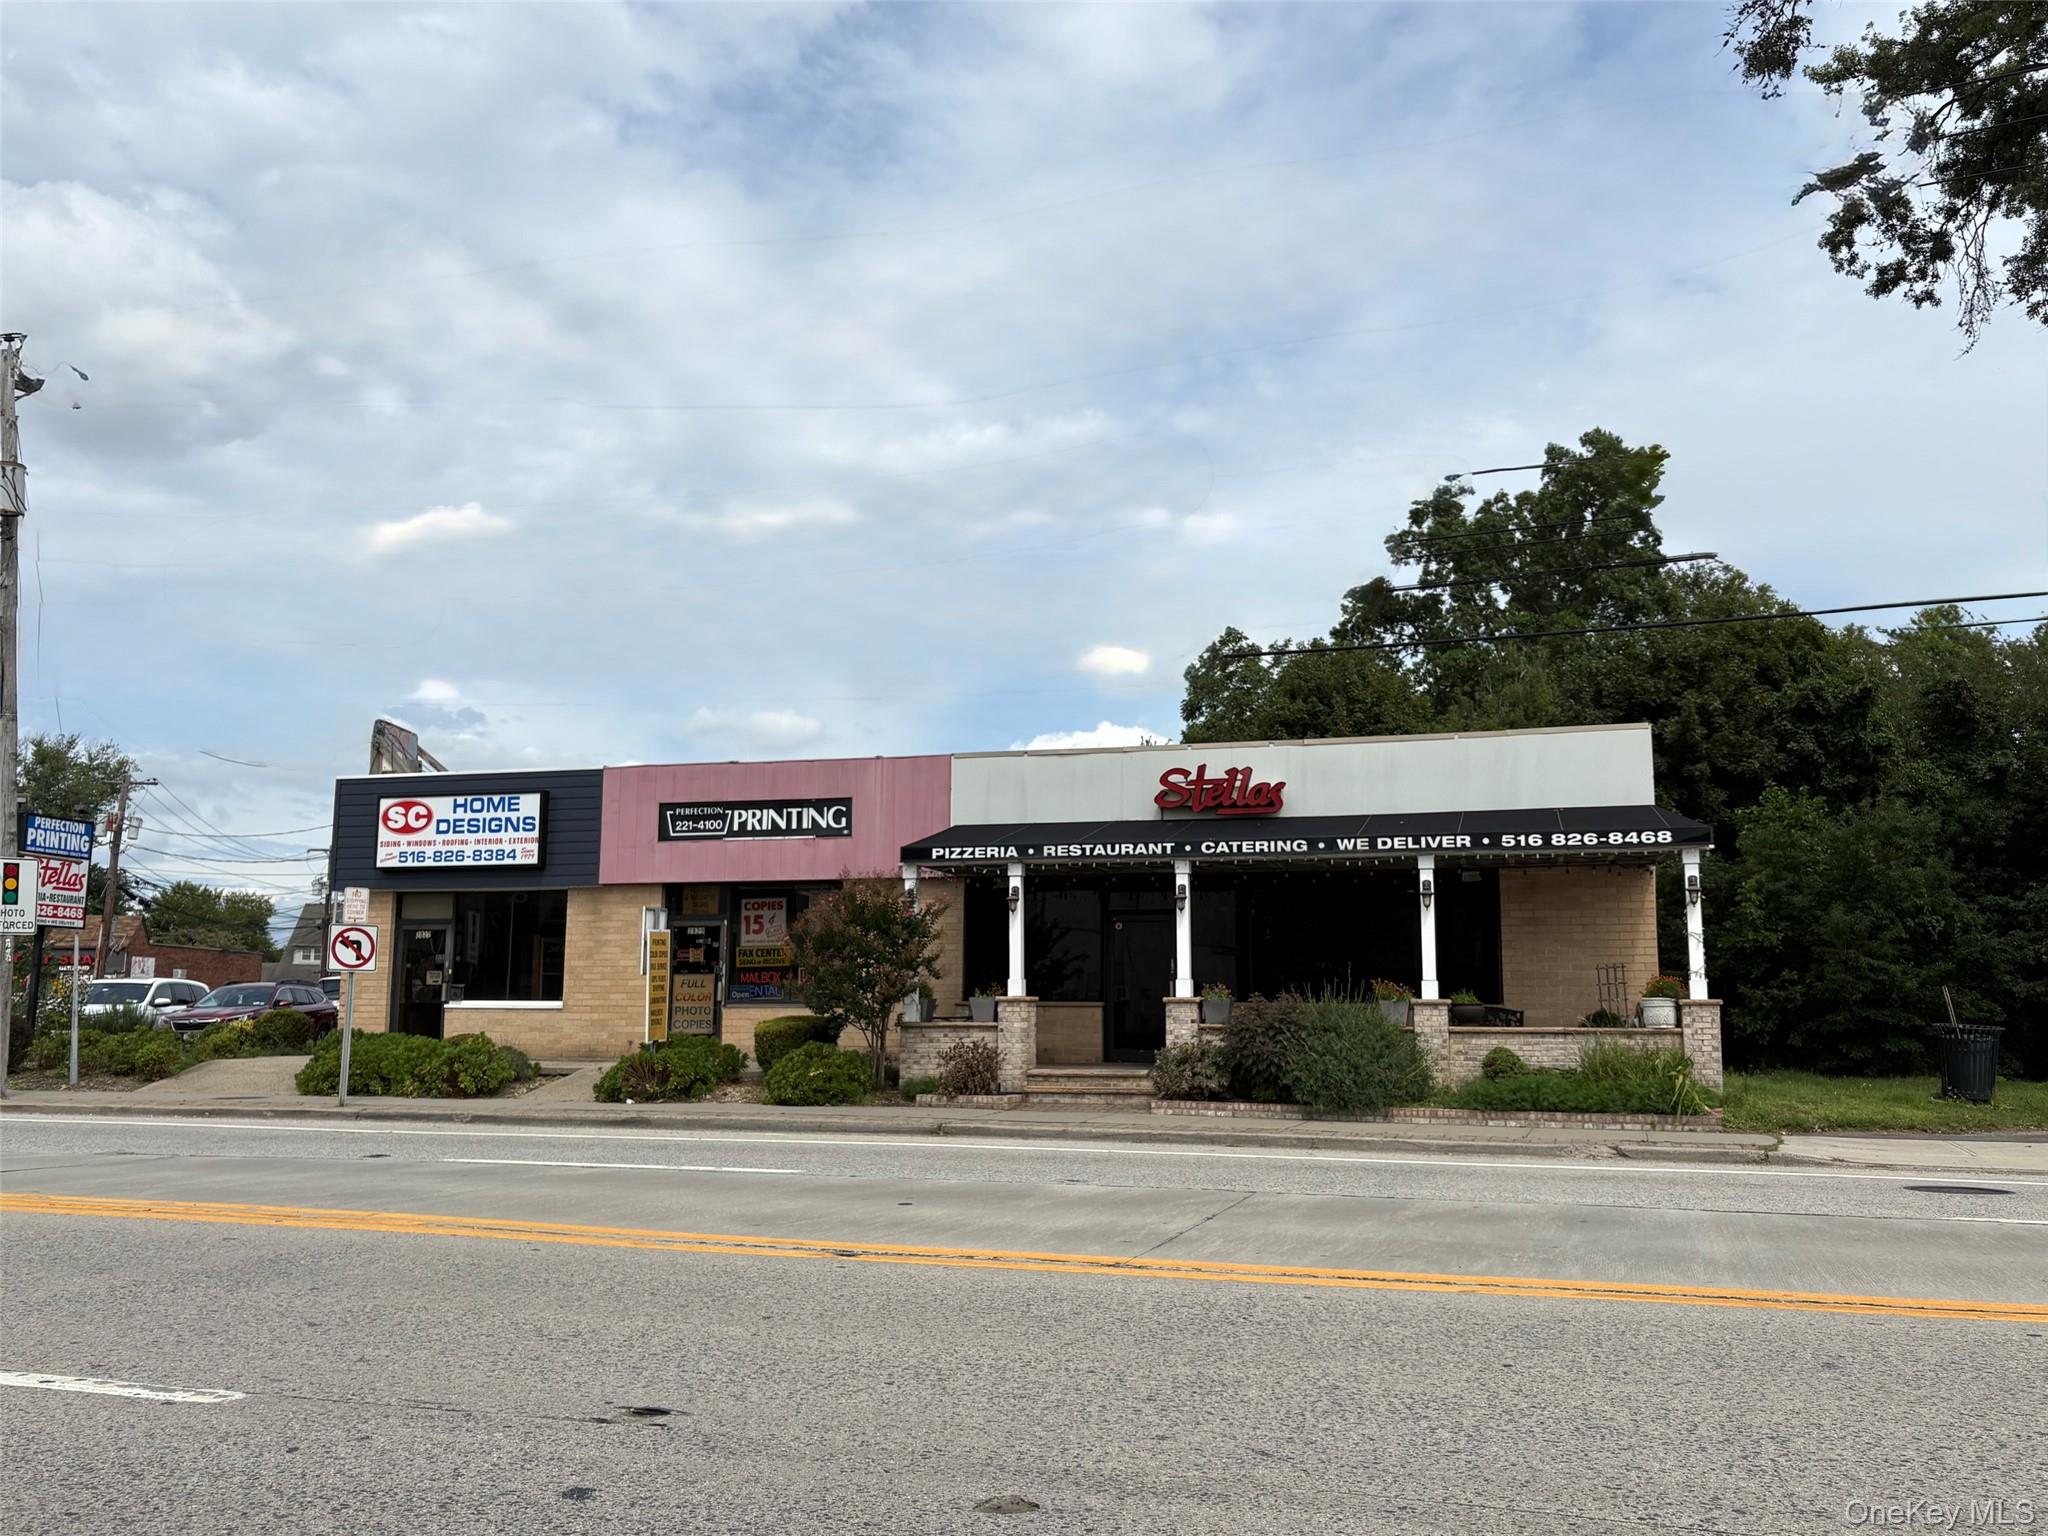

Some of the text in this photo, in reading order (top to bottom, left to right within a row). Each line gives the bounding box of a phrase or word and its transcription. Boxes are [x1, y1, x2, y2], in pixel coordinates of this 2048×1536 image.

[1154, 764, 1286, 815] Stellas
[453, 796, 520, 814] HOME
[676, 806, 724, 816] PERFECTION
[386, 805, 428, 829] SC
[733, 806, 847, 831] PRINTING
[34, 816, 85, 834] PERFECTION
[435, 816, 536, 835] DESIGNS
[675, 819, 723, 831] 221-4100
[26, 828, 90, 852] PRINTING
[380, 840, 401, 848] SIDING
[406, 839, 437, 848] WINDOWS
[441, 838, 469, 847] ROOFING
[474, 837, 503, 846] INTERIOR
[932, 831, 1673, 860] PIZZERIA RESTAURANT CATERING WE DELIVER 516 826-8468
[398, 848, 517, 864] 516-826-8384
[49, 893, 84, 905] RESTAURANT
[744, 900, 784, 911] COPIES
[744, 914, 765, 935] 15
[738, 947, 786, 958] FAX CENTE
[680, 979, 707, 989] FULL
[740, 972, 780, 984] MAILBOX
[675, 992, 713, 1002] COLOR
[732, 991, 749, 1000] Open
[749, 986, 781, 997] ENTAL
[675, 1006, 711, 1016] PHOTO
[673, 1019, 712, 1030] COPIES
